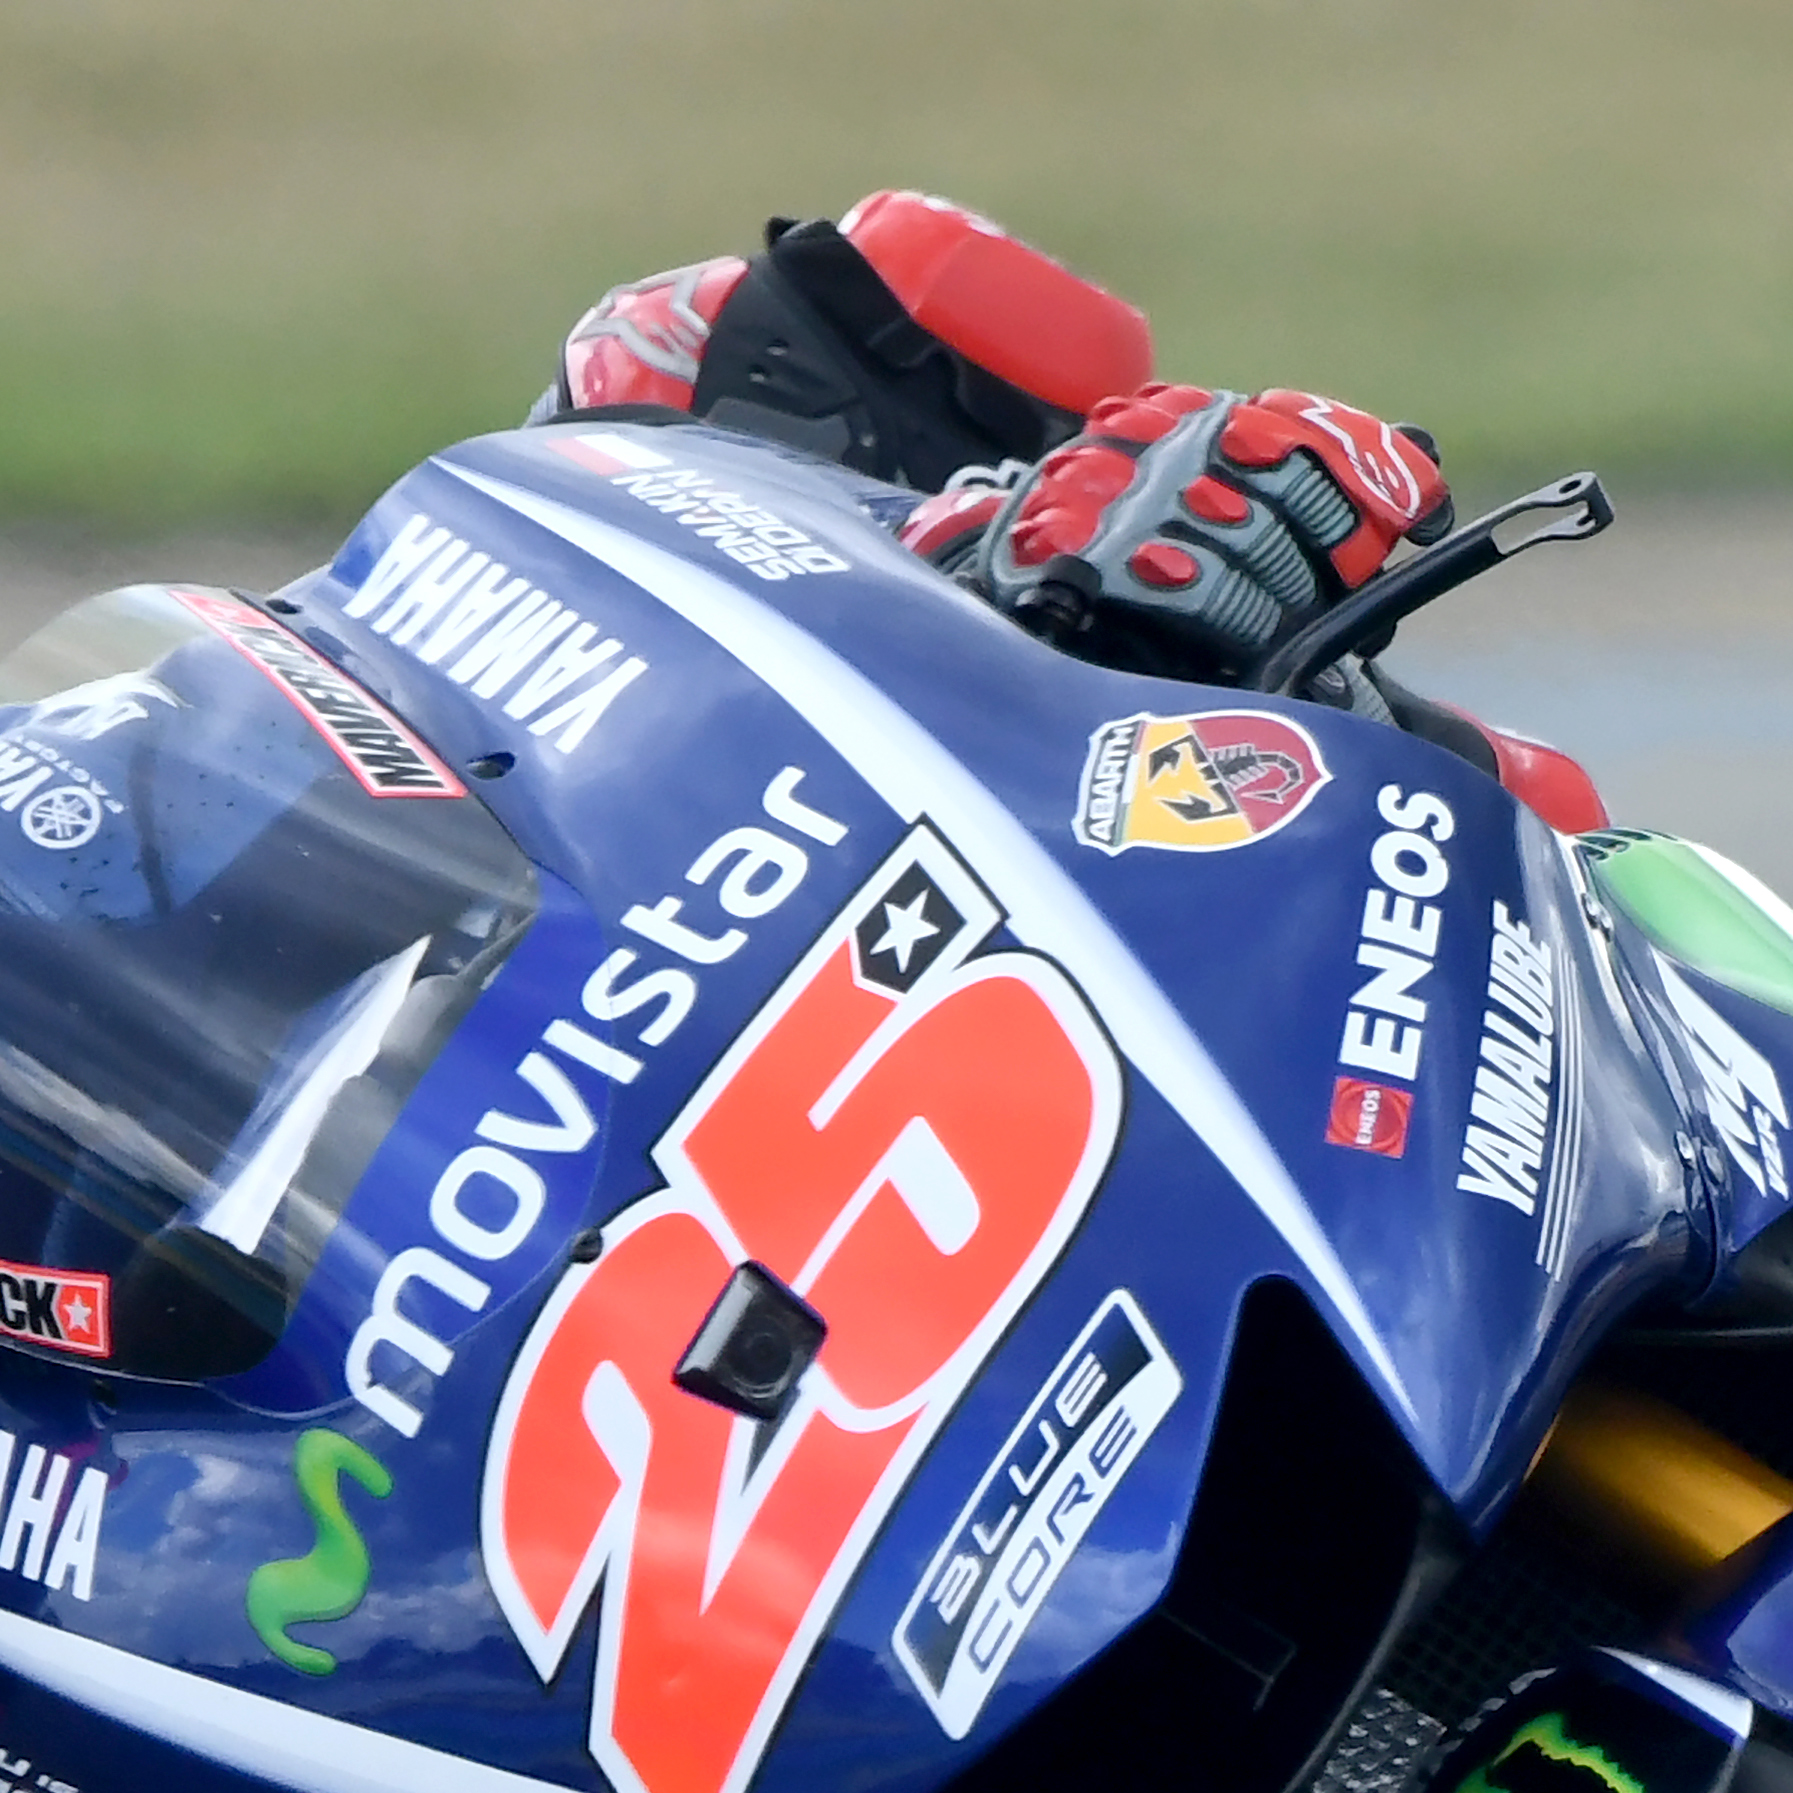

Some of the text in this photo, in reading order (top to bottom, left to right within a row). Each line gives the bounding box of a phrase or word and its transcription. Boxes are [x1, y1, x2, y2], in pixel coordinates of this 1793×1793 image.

[341, 512, 649, 754] YAMAHA
[1086, 721, 1137, 842] ABARTH
[1337, 782, 1457, 1081] ENEOS
[1456, 901, 1556, 1216] YAMALUBE
[345, 766, 849, 1438] movistar
[1355, 1088, 1381, 1148] ENEOS
[929, 1351, 1107, 1625] BLUE
[968, 1406, 1137, 1674] CORE
